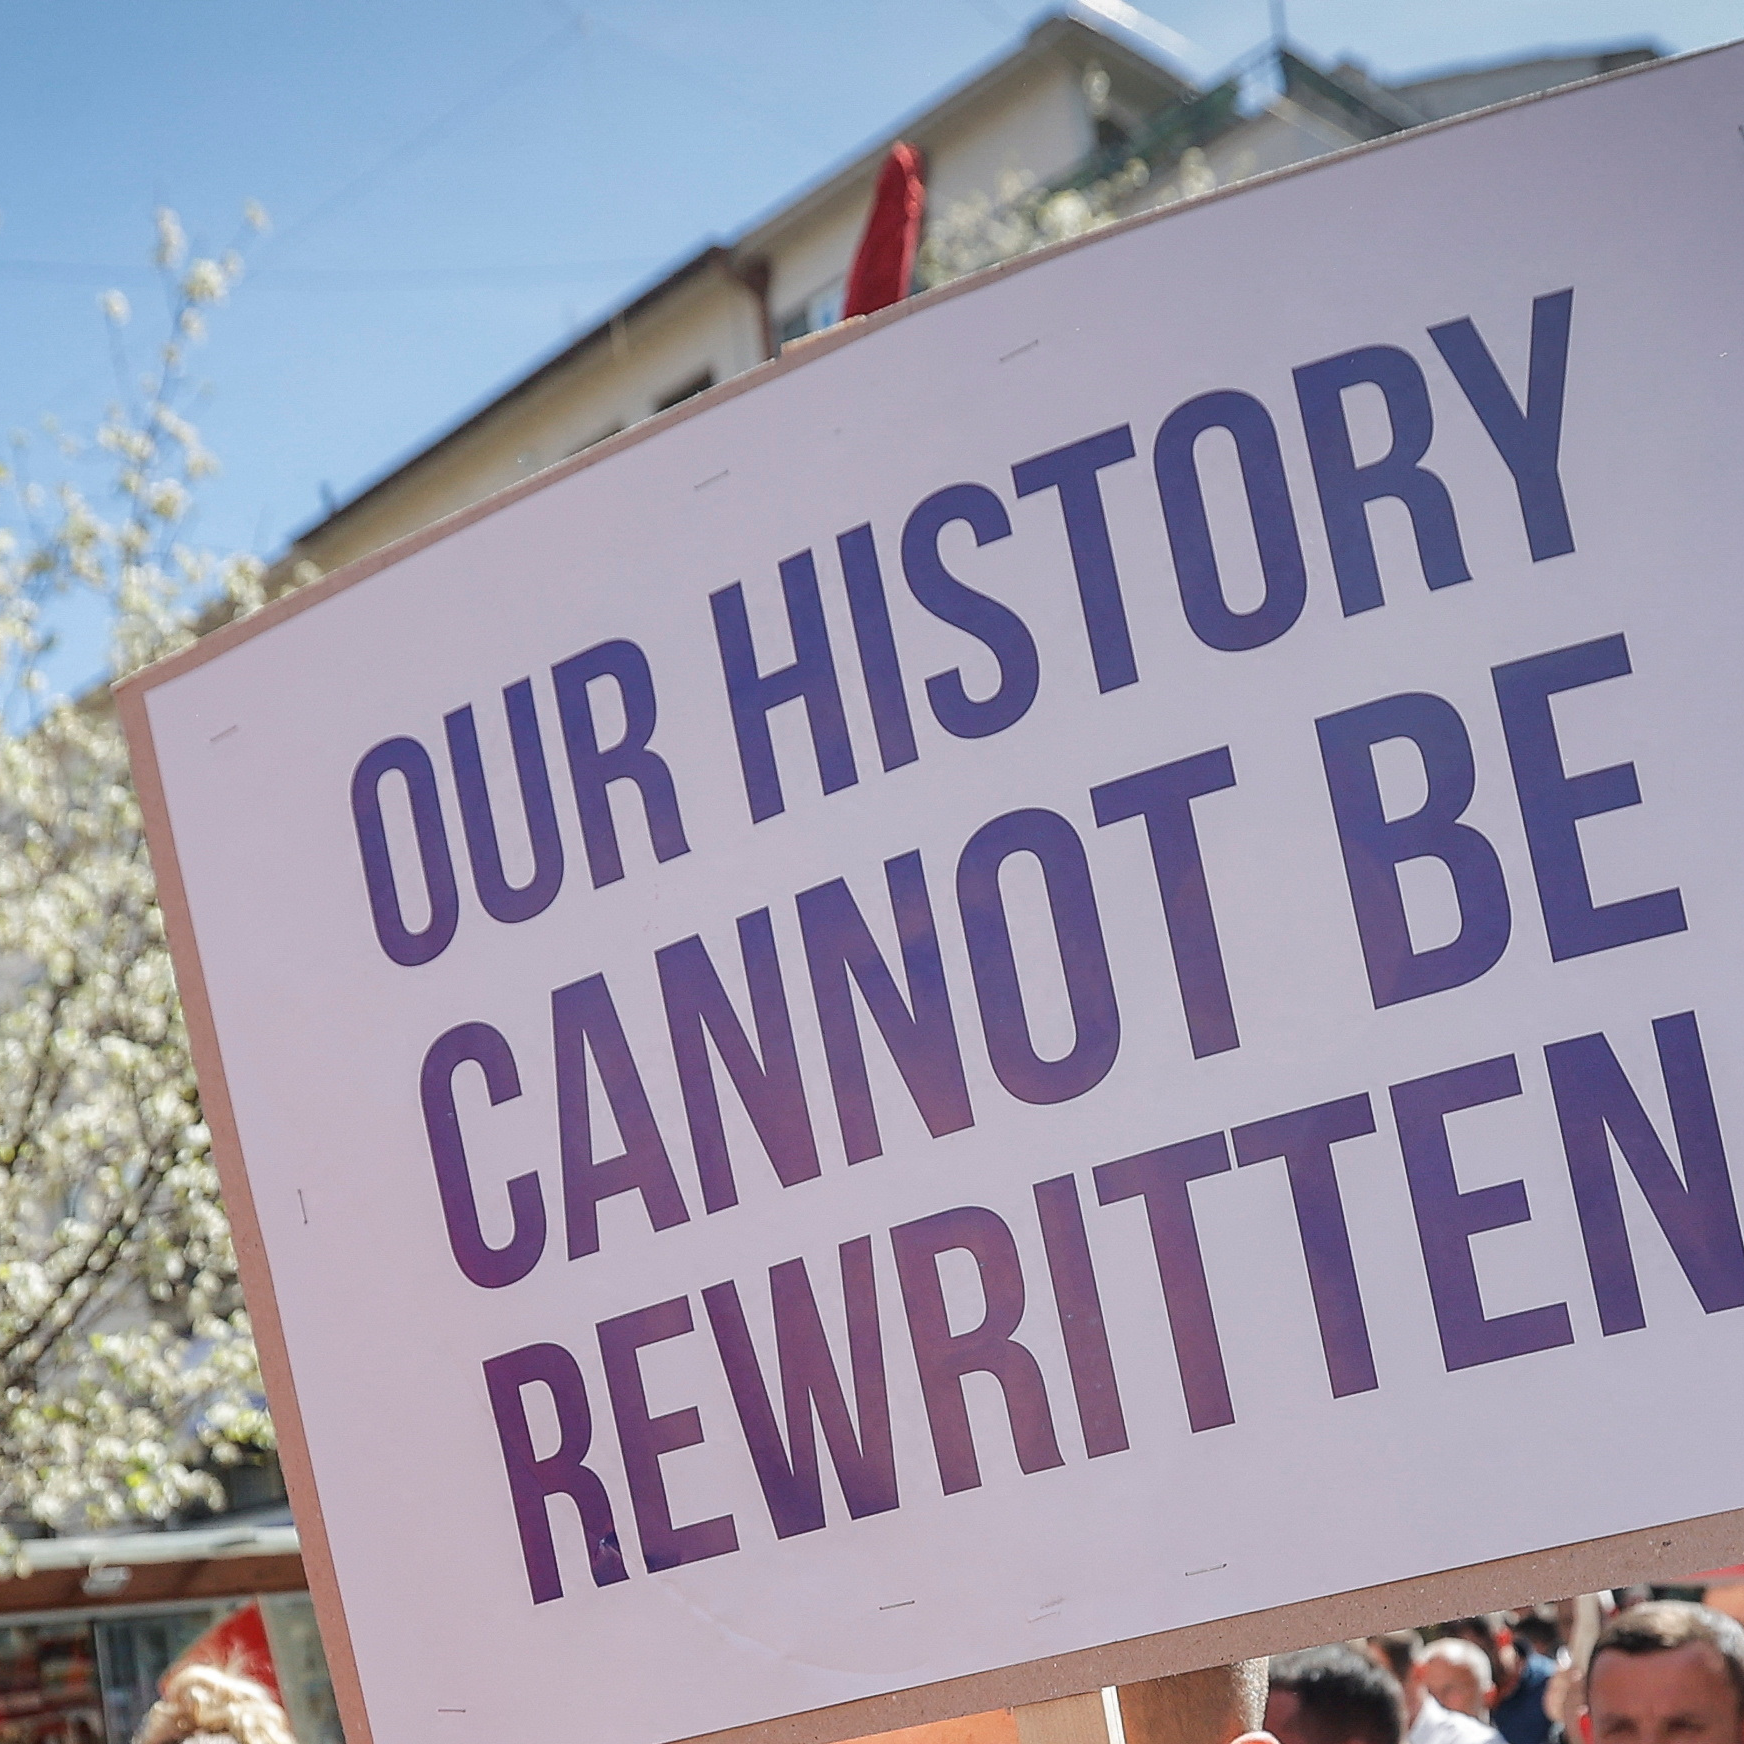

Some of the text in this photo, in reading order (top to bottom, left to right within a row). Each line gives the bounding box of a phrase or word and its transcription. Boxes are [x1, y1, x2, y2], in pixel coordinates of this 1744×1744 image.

[350, 287, 1576, 967] OUR HISTORY
[419, 632, 1689, 1289] CANNOT BE
